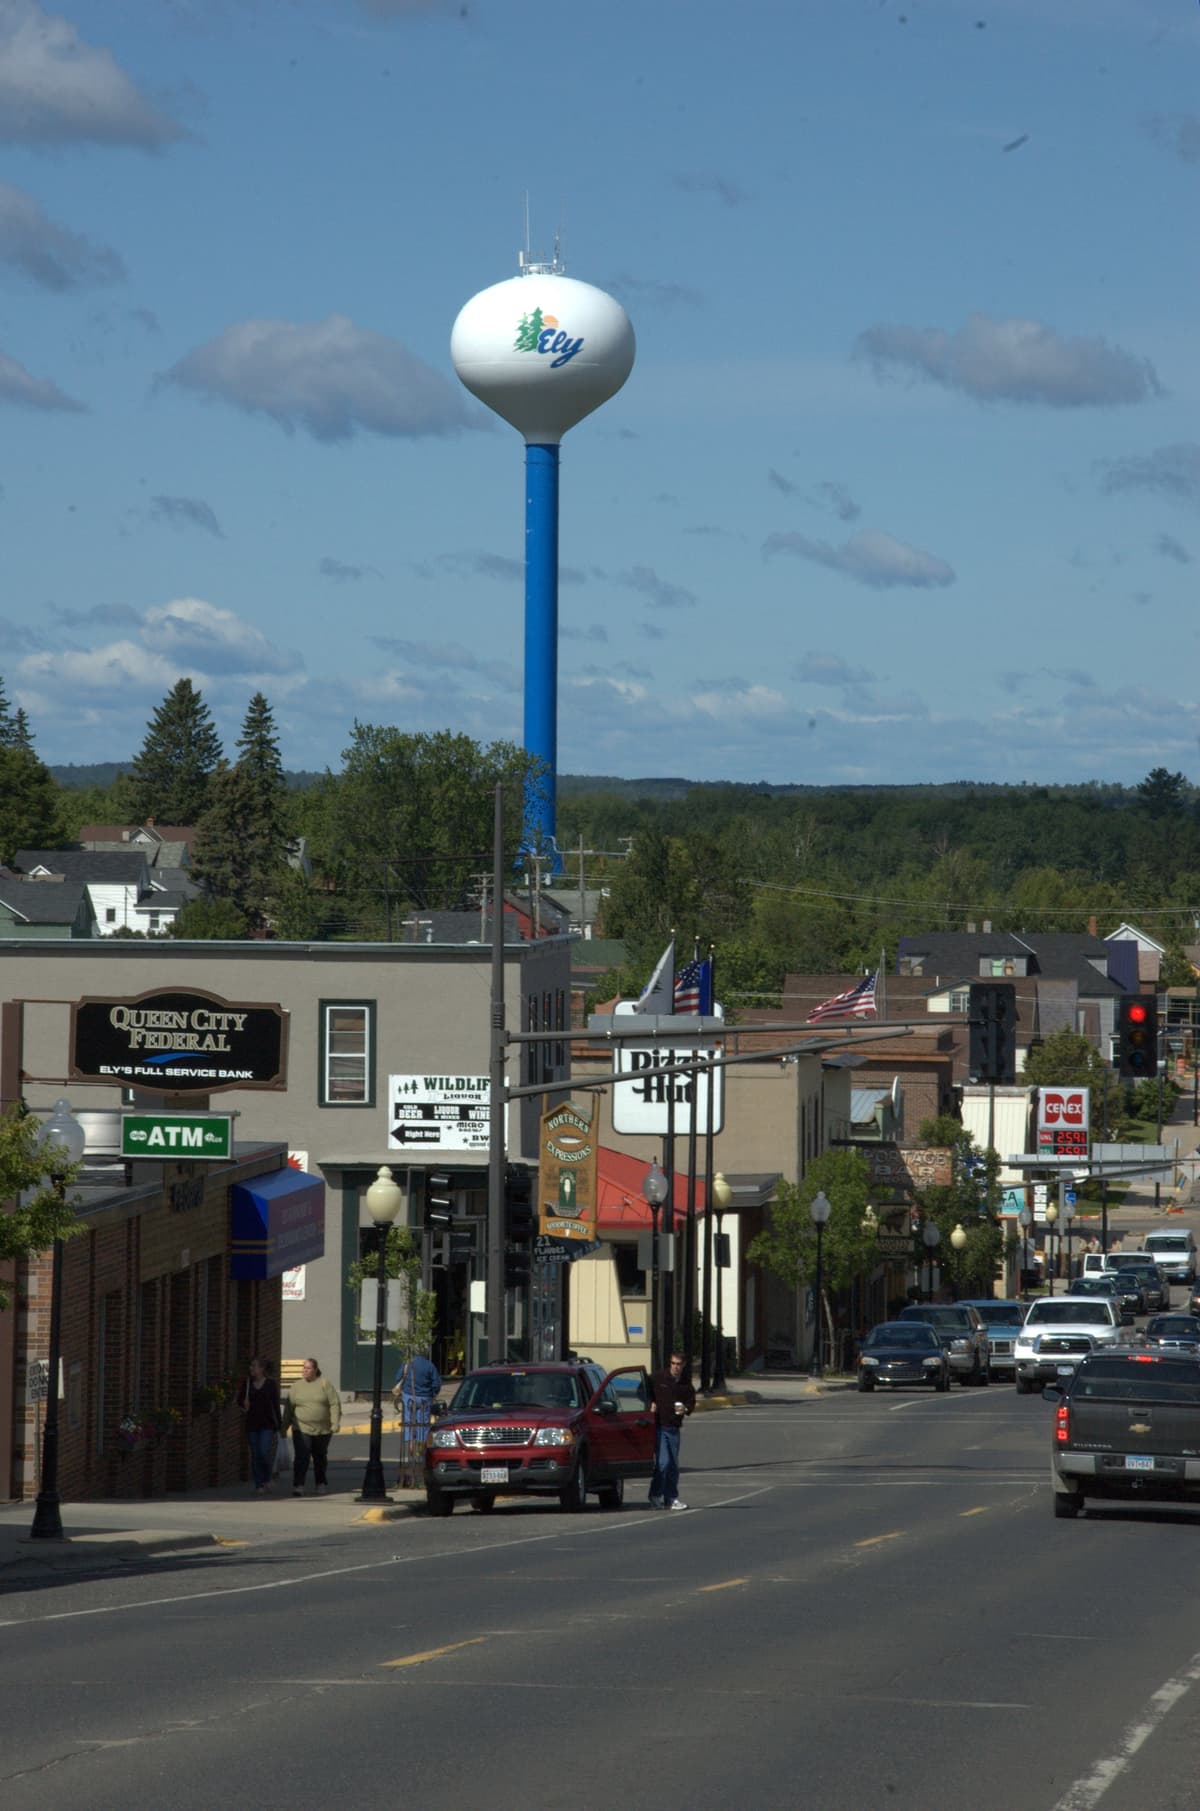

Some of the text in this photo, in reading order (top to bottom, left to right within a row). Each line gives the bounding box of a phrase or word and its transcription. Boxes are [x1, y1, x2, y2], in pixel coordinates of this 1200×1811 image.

[538, 328, 584, 368] Ely
[110, 1006, 247, 1031] QUEEN CITY
[128, 1028, 231, 1051] FEDERAL
[100, 1065, 253, 1078] ELY'S FULL SERVICE BANK
[424, 1078, 490, 1091] WILDLIF
[398, 1109, 423, 1119] BEER
[1046, 1103, 1082, 1113] CENEX
[548, 1113, 589, 1134] NORTHERN
[147, 1126, 203, 1147] ATM
[546, 1140, 591, 1161] EXPRESSIONS
[536, 1236, 551, 1247] 21
